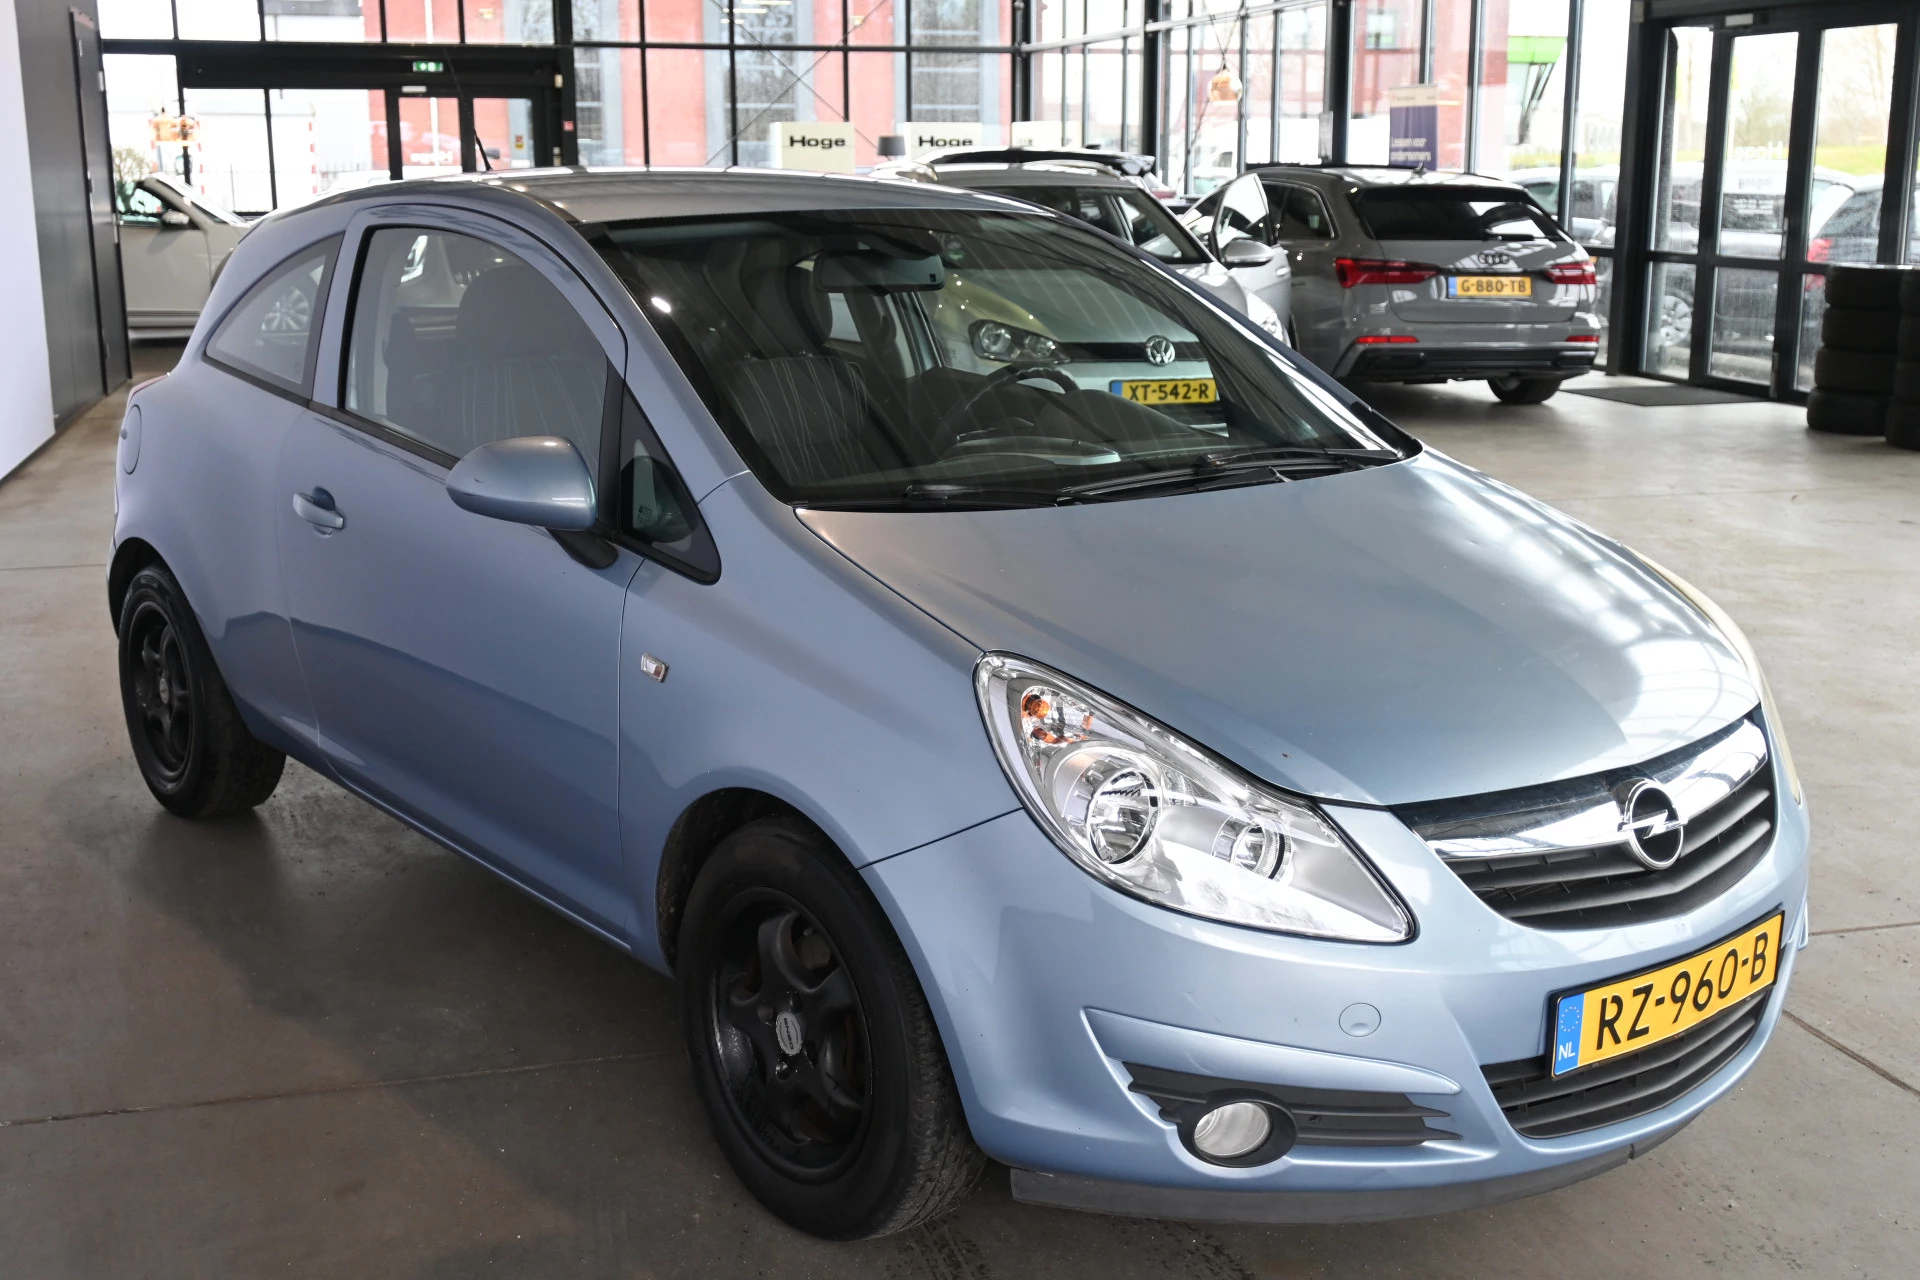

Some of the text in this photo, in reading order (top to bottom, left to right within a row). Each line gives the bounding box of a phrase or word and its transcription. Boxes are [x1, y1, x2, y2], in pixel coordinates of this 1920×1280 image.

[789, 135, 846, 149] Hoge
[918, 136, 973, 147] Hoge
[1461, 280, 1527, 293] G-880-TB
[1129, 383, 1210, 402] XT-542-R
[1596, 931, 1769, 1051] RZ-960-B
[1558, 1041, 1576, 1061] NL
